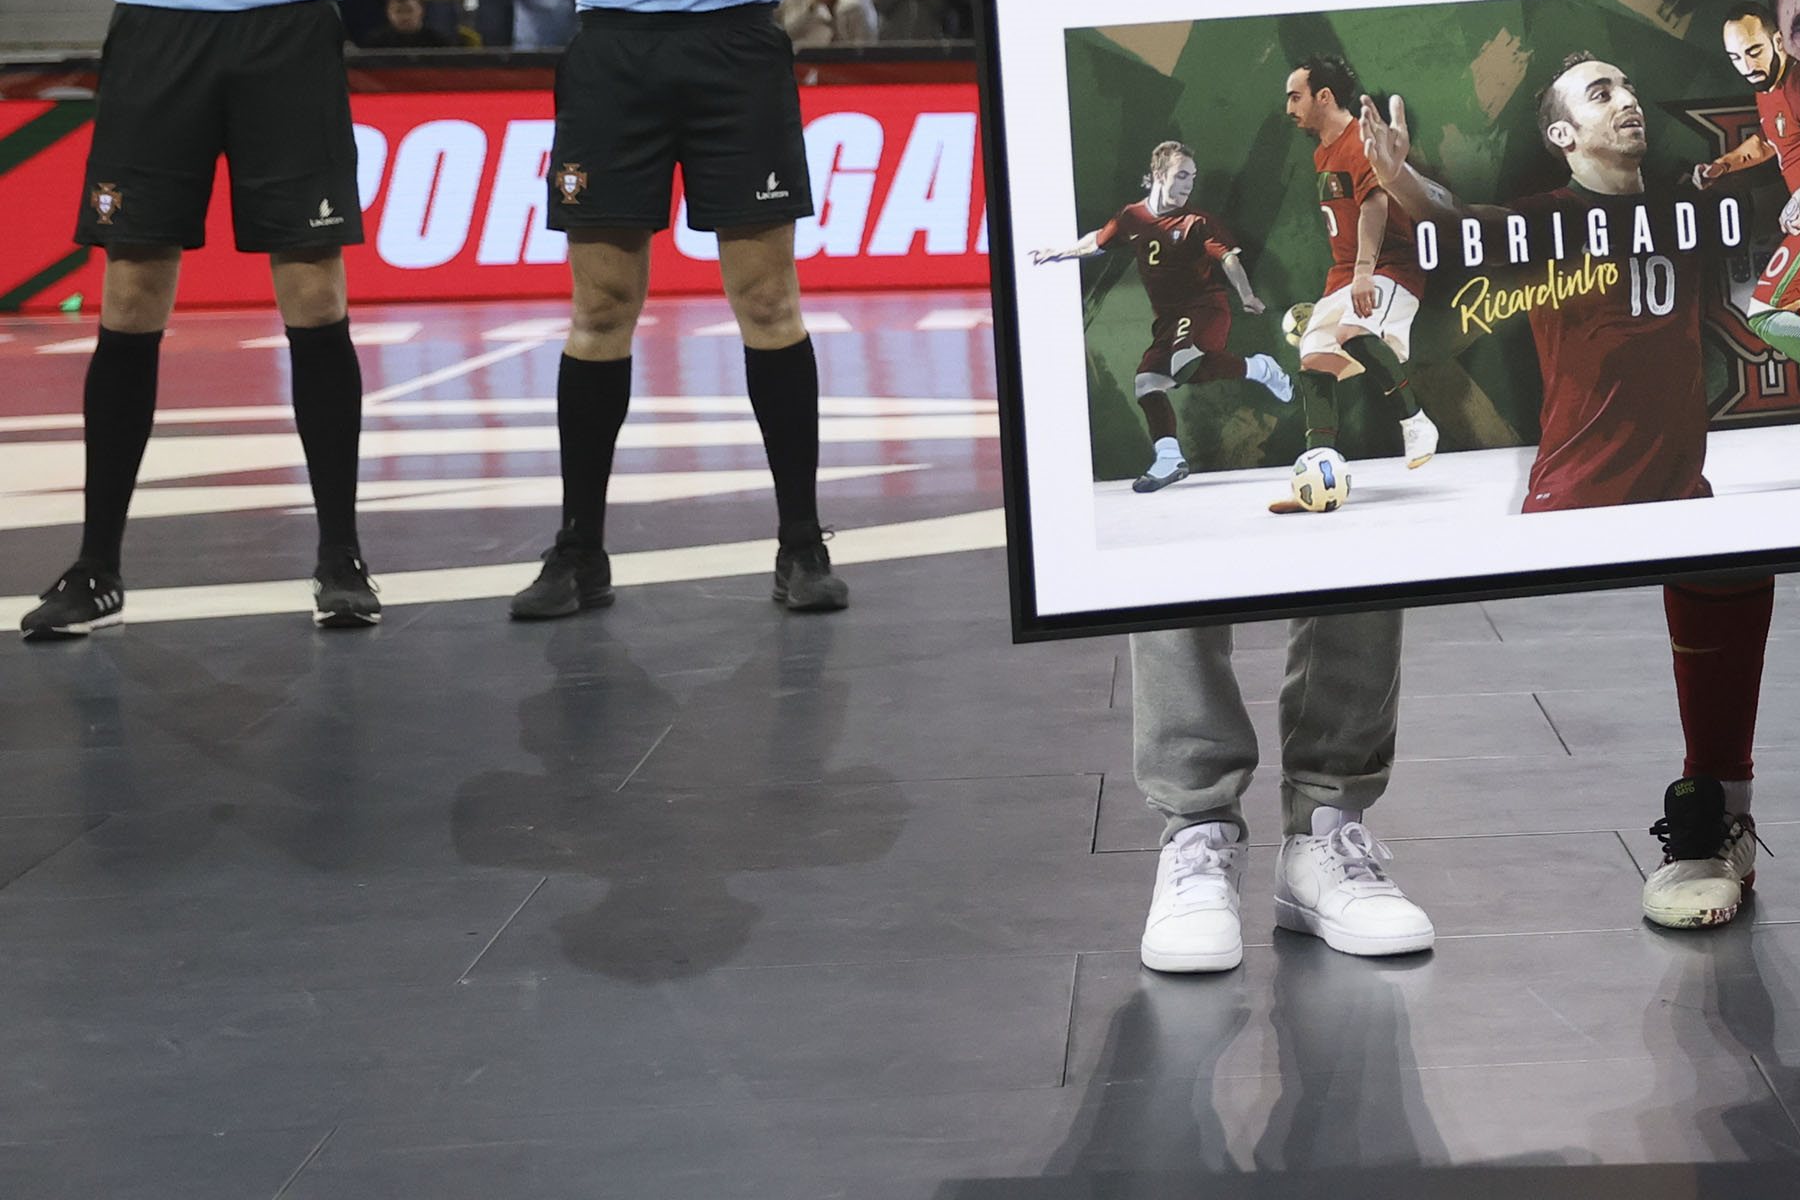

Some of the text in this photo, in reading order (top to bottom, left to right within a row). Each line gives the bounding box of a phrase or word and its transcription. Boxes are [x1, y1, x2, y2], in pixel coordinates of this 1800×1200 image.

[1149, 240, 1161, 266] 2
[1416, 197, 1741, 271] OBRIGADO
[1451, 252, 1619, 335] Ricardinho
[1629, 255, 1676, 317] 10
[1177, 317, 1191, 338] 2
